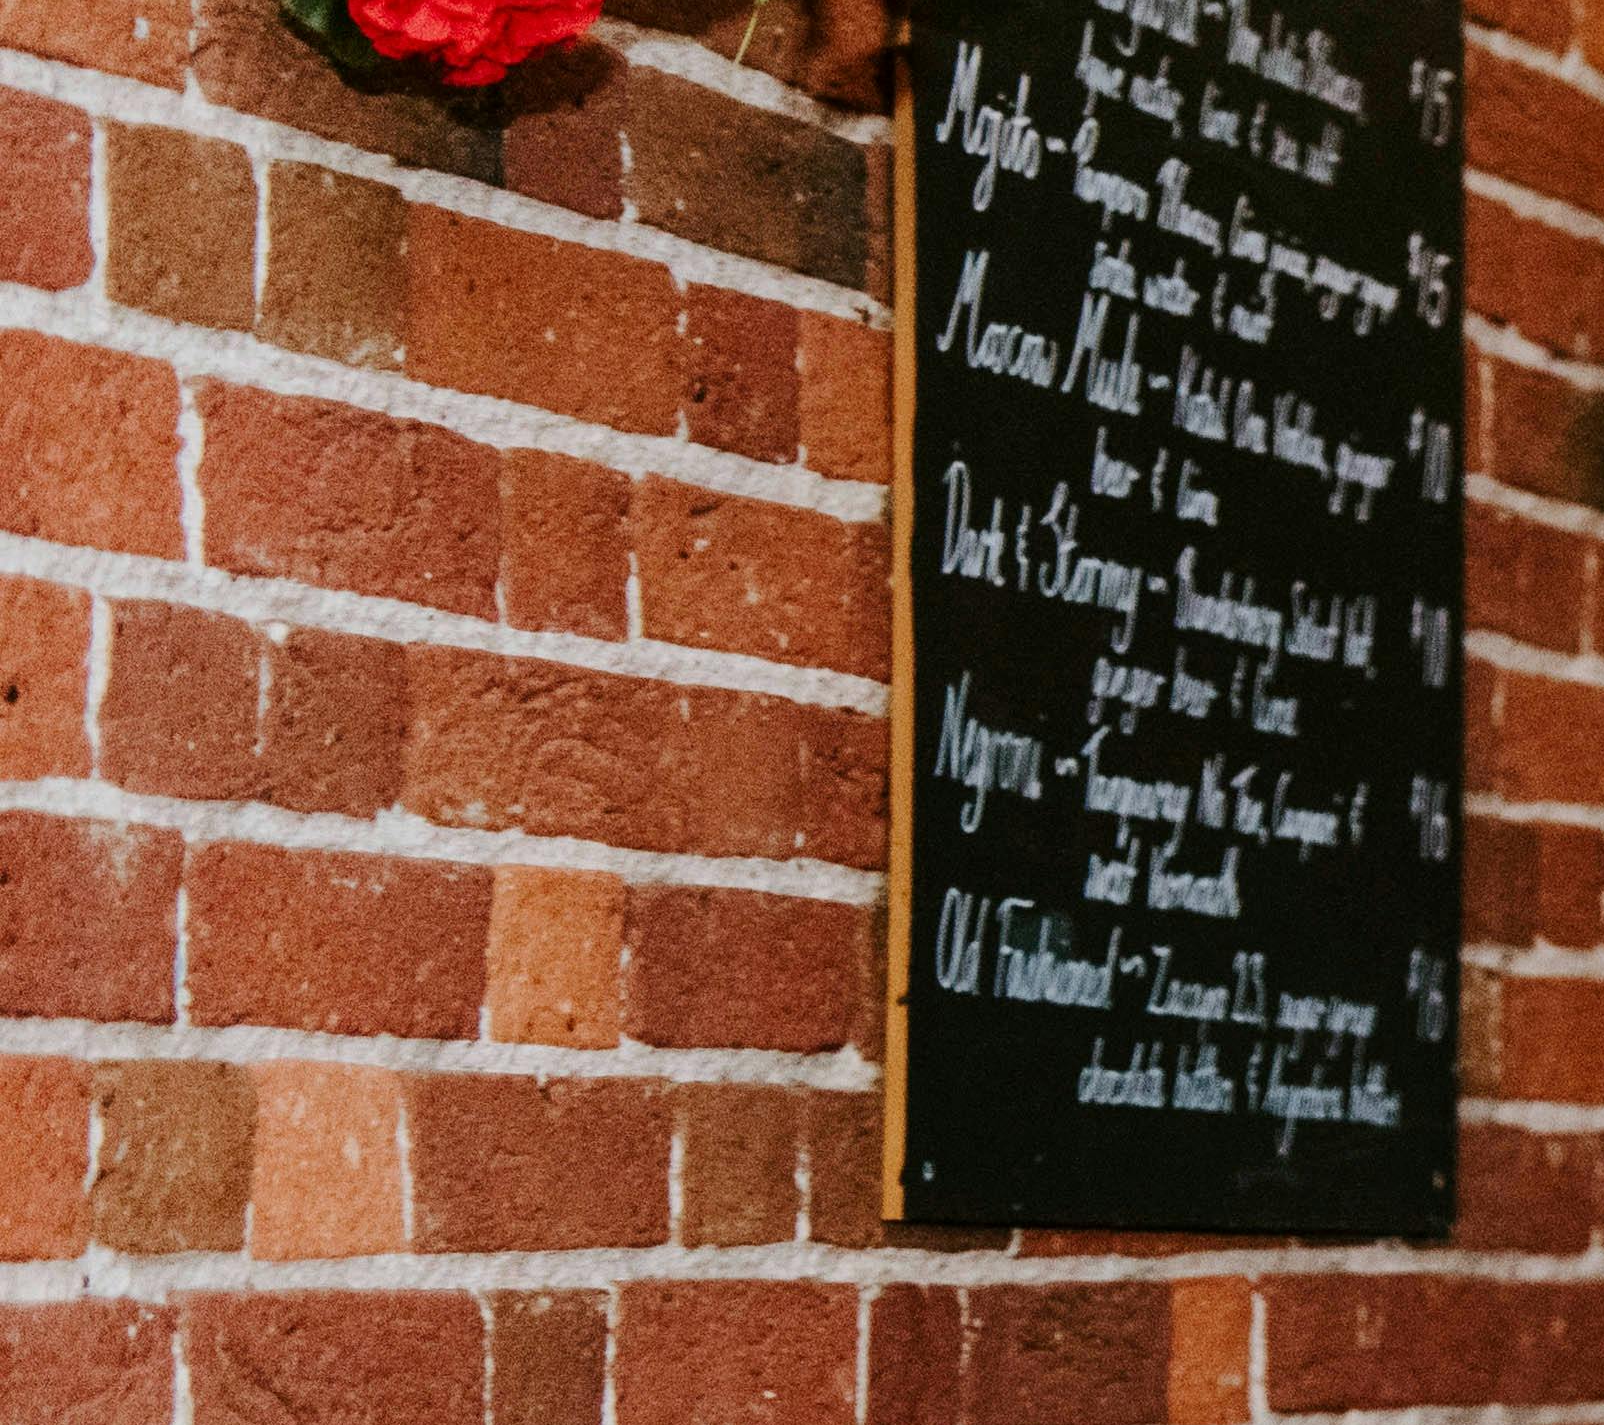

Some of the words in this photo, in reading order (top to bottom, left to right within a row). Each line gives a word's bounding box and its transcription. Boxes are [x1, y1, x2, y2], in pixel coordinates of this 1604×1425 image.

[935, 40, 1041, 213] Mojito
[936, 249, 1058, 388] Moscow
[1060, 292, 1142, 417] Mule
[941, 459, 1006, 588] Dark
[1038, 481, 1143, 655] Stormy
[933, 671, 1043, 835] Negroni
[935, 886, 990, 995] Old
[994, 896, 1121, 1008] Fashioned
